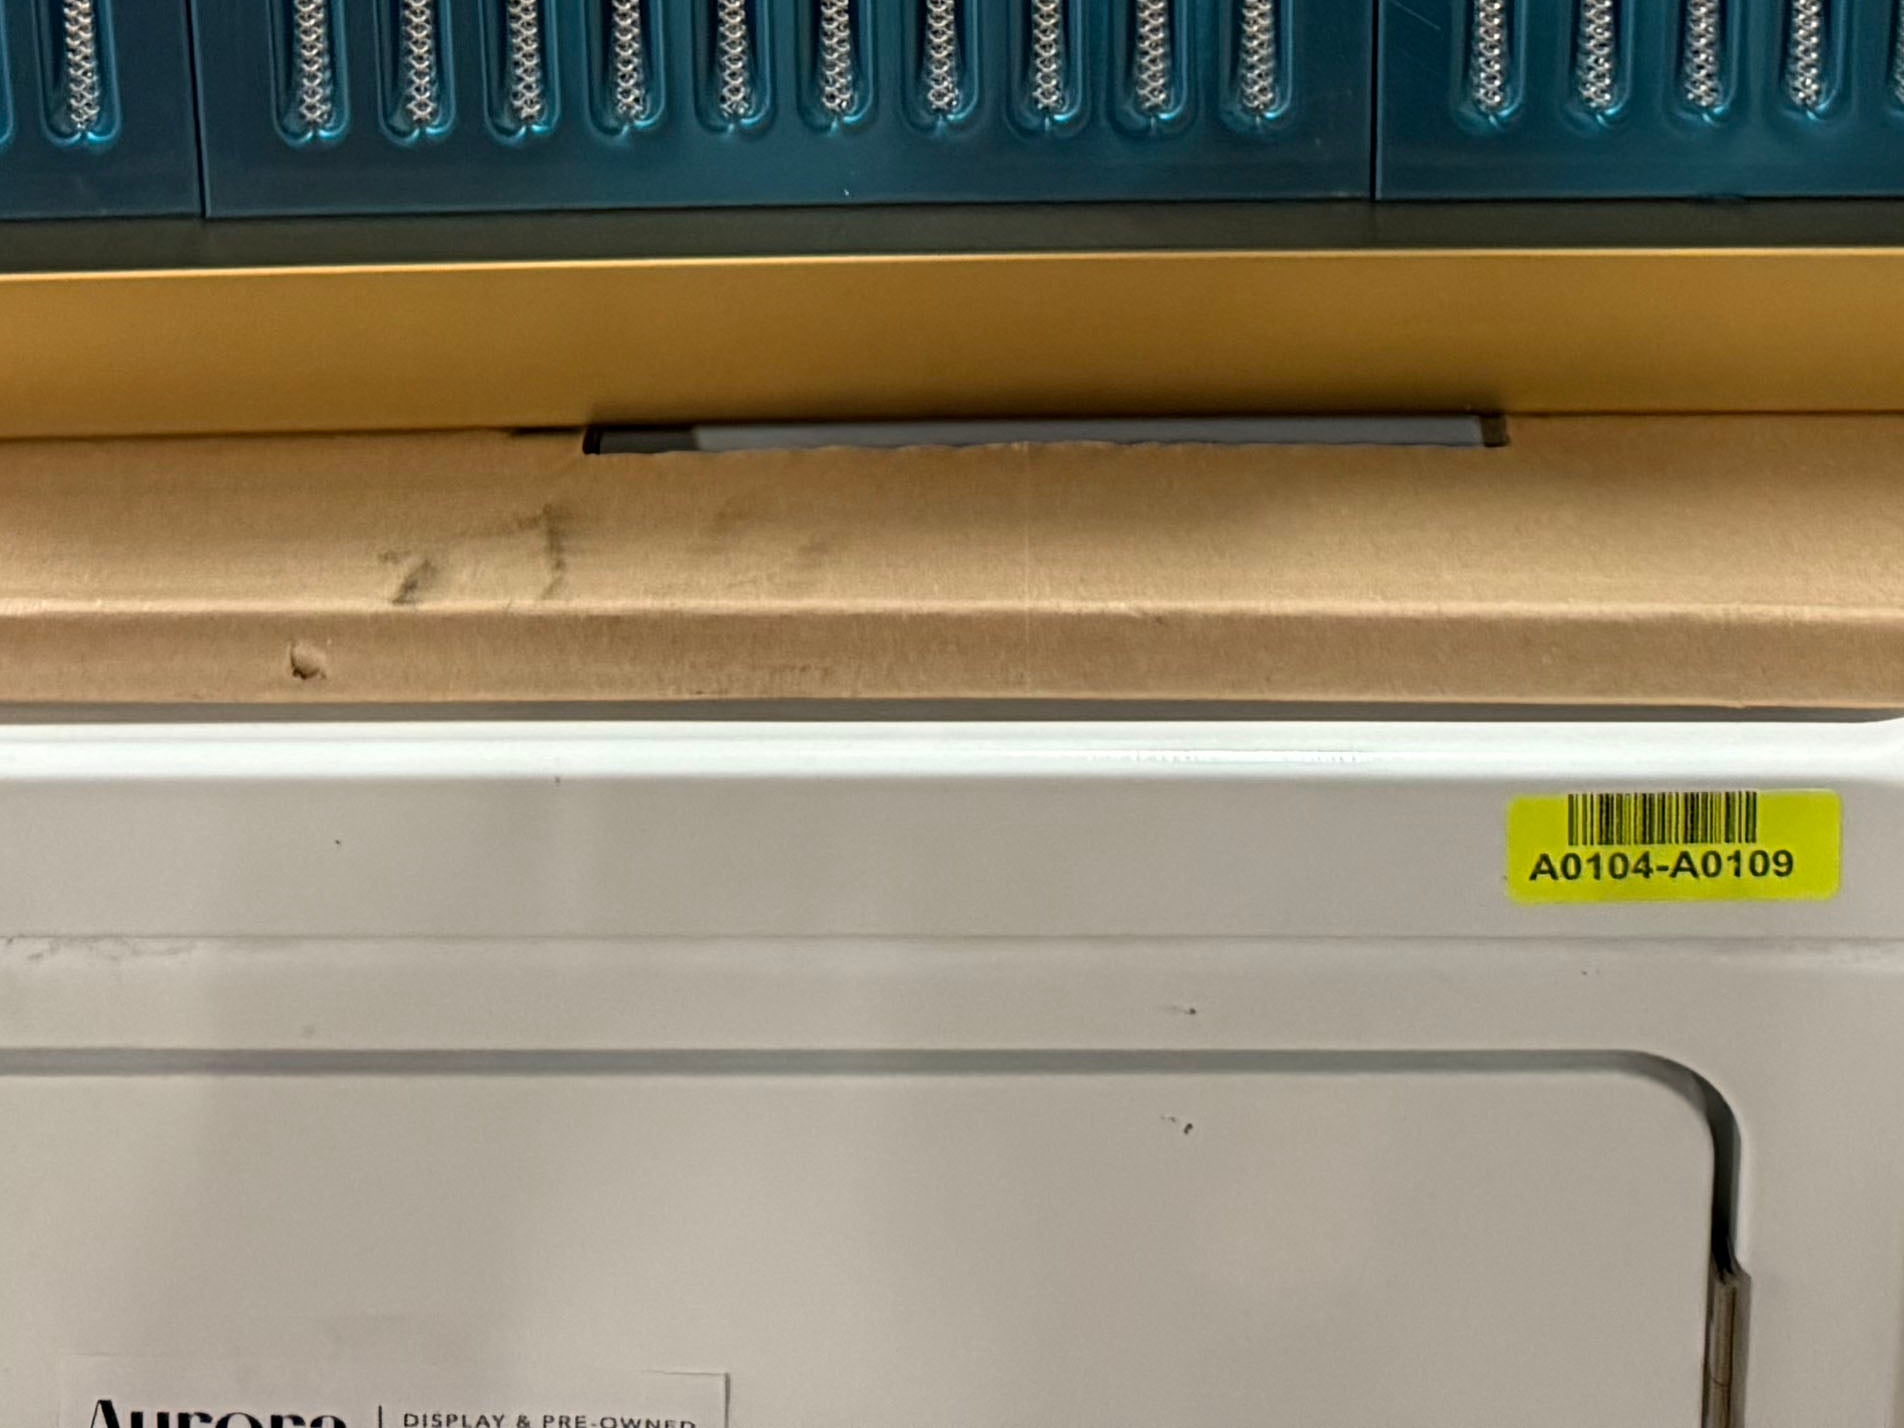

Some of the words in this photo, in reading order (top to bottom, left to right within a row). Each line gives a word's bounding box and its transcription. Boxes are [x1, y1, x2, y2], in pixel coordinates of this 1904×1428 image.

[1529, 849, 1795, 882] A0104-A0109
[403, 1412, 506, 1428] DISPLAY
[542, 1414, 697, 1428] PRE-OWNED
